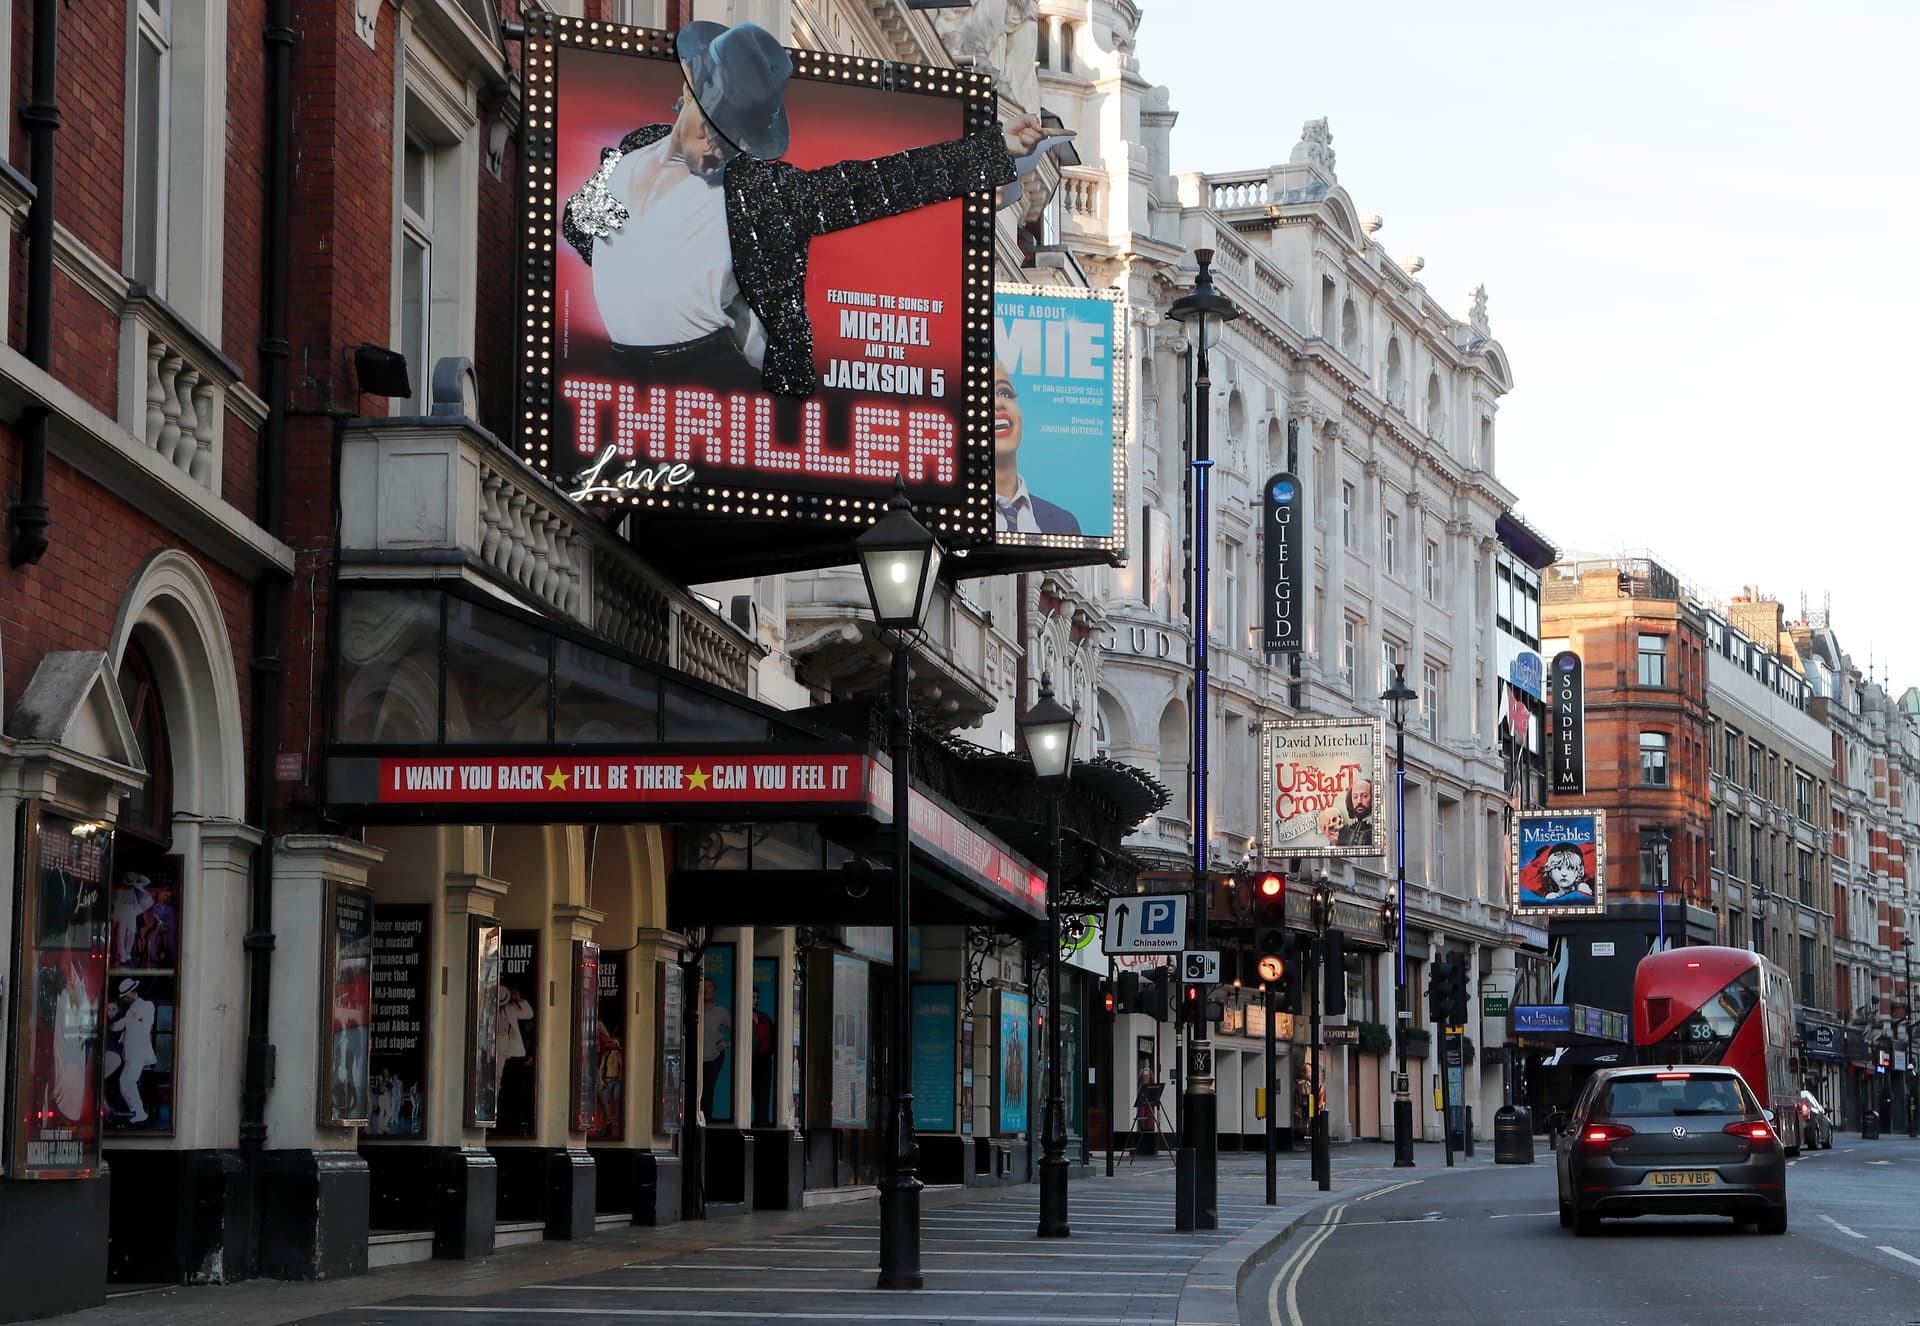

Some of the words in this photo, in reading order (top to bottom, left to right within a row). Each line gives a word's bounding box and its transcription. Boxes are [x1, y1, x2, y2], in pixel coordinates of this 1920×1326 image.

[827, 289, 877, 307] FEATURING
[879, 295, 896, 309] THE
[898, 297, 930, 312] SONGS
[932, 301, 944, 314] OF
[995, 304, 1024, 317] KING
[1028, 305, 1067, 319] ABOUT
[840, 309, 931, 346] MICHAEL
[865, 343, 885, 358] AND
[888, 345, 905, 360] THE
[995, 317, 1104, 380] MIE
[823, 359, 923, 395] JACKSON
[931, 368, 945, 397] 5
[564, 379, 953, 483] THRILLER
[569, 444, 695, 501] Live
[1275, 506, 1292, 638] GIELGUD
[1267, 639, 1300, 648] THEATRE
[1561, 674, 1574, 783] SONDHEIM
[1276, 735, 1310, 749] David
[1314, 733, 1369, 748] Mitchell
[1281, 751, 1308, 759] William
[1309, 751, 1350, 760] Shakespeare
[394, 766, 400, 790] I
[406, 766, 454, 790] WANT
[460, 766, 492, 790] YOU
[498, 766, 544, 790] BACK
[573, 765, 602, 789] I'LL
[608, 766, 629, 790] BE
[634, 766, 684, 790] THERE
[712, 766, 747, 790] CAN
[752, 765, 786, 790] YOU
[791, 765, 826, 790] FEEL
[832, 765, 849, 790] IT
[1275, 792, 1338, 820] Crow
[1548, 821, 1564, 832] Les
[1524, 827, 1591, 843] Misérables
[1147, 903, 1169, 931] P
[394, 920, 422, 933] majesty
[385, 936, 413, 948] musical
[1133, 939, 1178, 947] Chinatown
[405, 953, 418, 965] will
[393, 969, 408, 981] that
[379, 1004, 409, 1017] surpass
[1535, 1010, 1547, 1019] Les
[392, 1019, 410, 1031] Abba
[411, 1021, 421, 1031] as
[1691, 1023, 1711, 1039] 38
[375, 1036, 388, 1048] End
[1654, 1173, 1685, 1185] LD67
[1687, 1173, 1711, 1184] VBG
